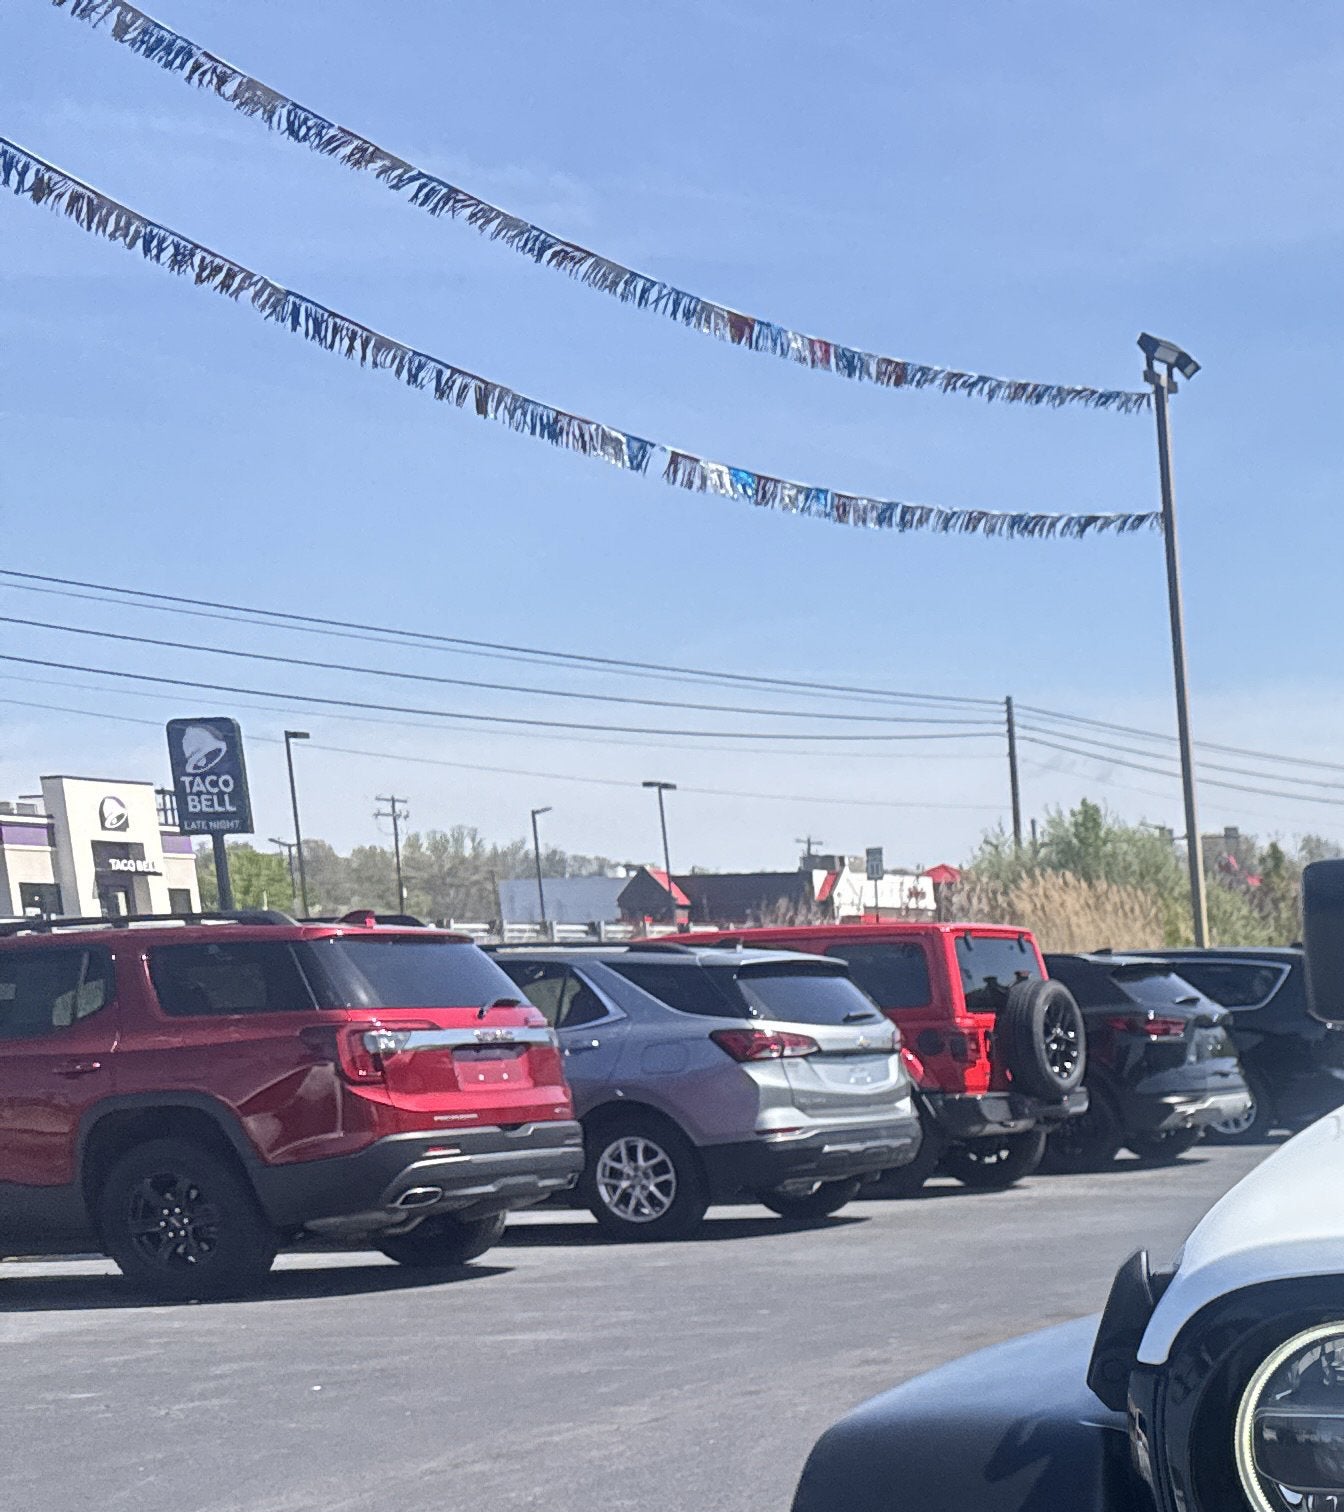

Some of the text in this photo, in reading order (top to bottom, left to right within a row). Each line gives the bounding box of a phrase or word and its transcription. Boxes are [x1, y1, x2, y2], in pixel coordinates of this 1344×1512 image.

[180, 774, 235, 793] TACO
[187, 793, 237, 813] BELL
[184, 819, 240, 831] LATE NIGHT
[108, 858, 136, 872] TACO
